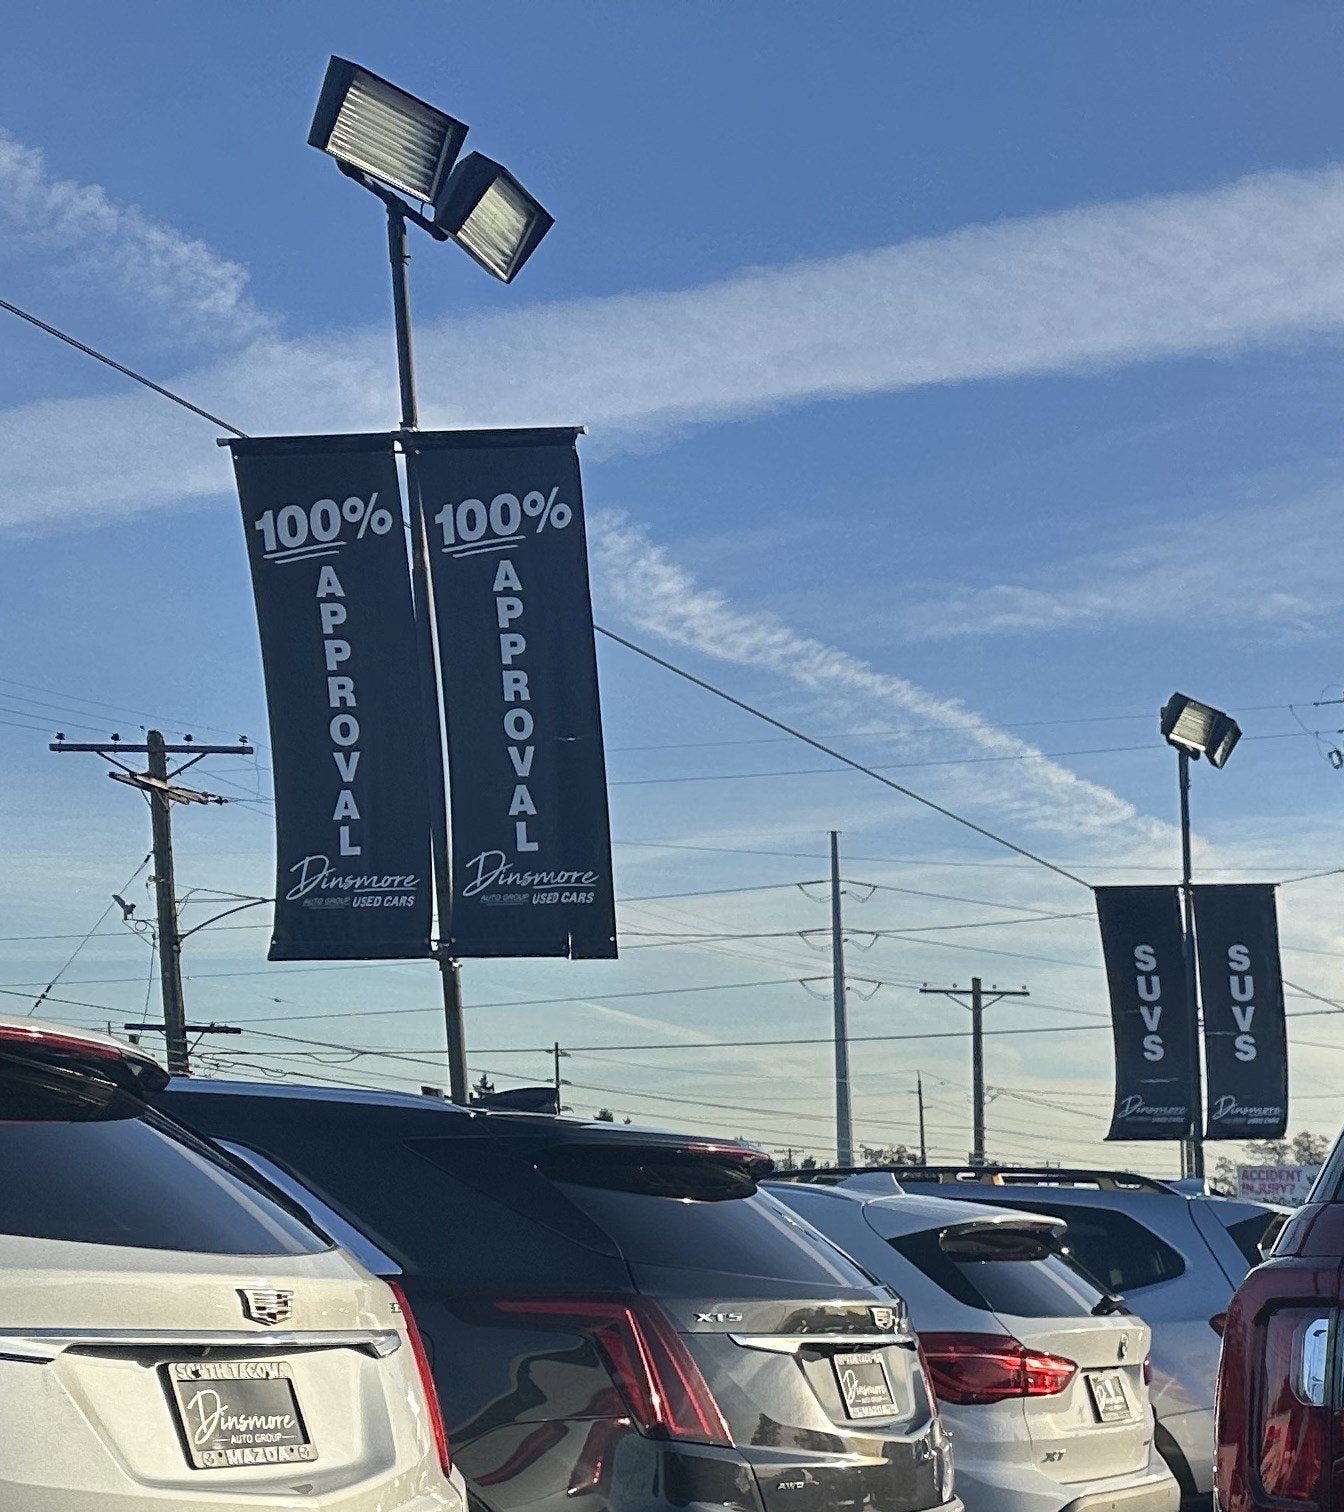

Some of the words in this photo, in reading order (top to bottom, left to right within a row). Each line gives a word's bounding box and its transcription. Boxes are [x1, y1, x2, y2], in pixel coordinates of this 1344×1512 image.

[255, 493, 393, 551] 100%
[434, 487, 572, 547] 100%
[316, 565, 361, 857] APPROVAL
[492, 559, 539, 853] APPROVAL
[286, 855, 421, 900] Dinsmore
[352, 897, 382, 908] USED
[383, 895, 415, 907] CARS
[463, 850, 599, 897] Dinsmore
[532, 893, 560, 905] USED
[561, 891, 594, 904] CARS
[1134, 944, 1165, 1062] SUVS
[1228, 944, 1257, 1062] SUVS
[187, 1389, 295, 1445] Dinsmore
[231, 1433, 253, 1444] AUTO
[255, 1432, 282, 1443] GROUP
[226, 1447, 291, 1465] MAZDA
